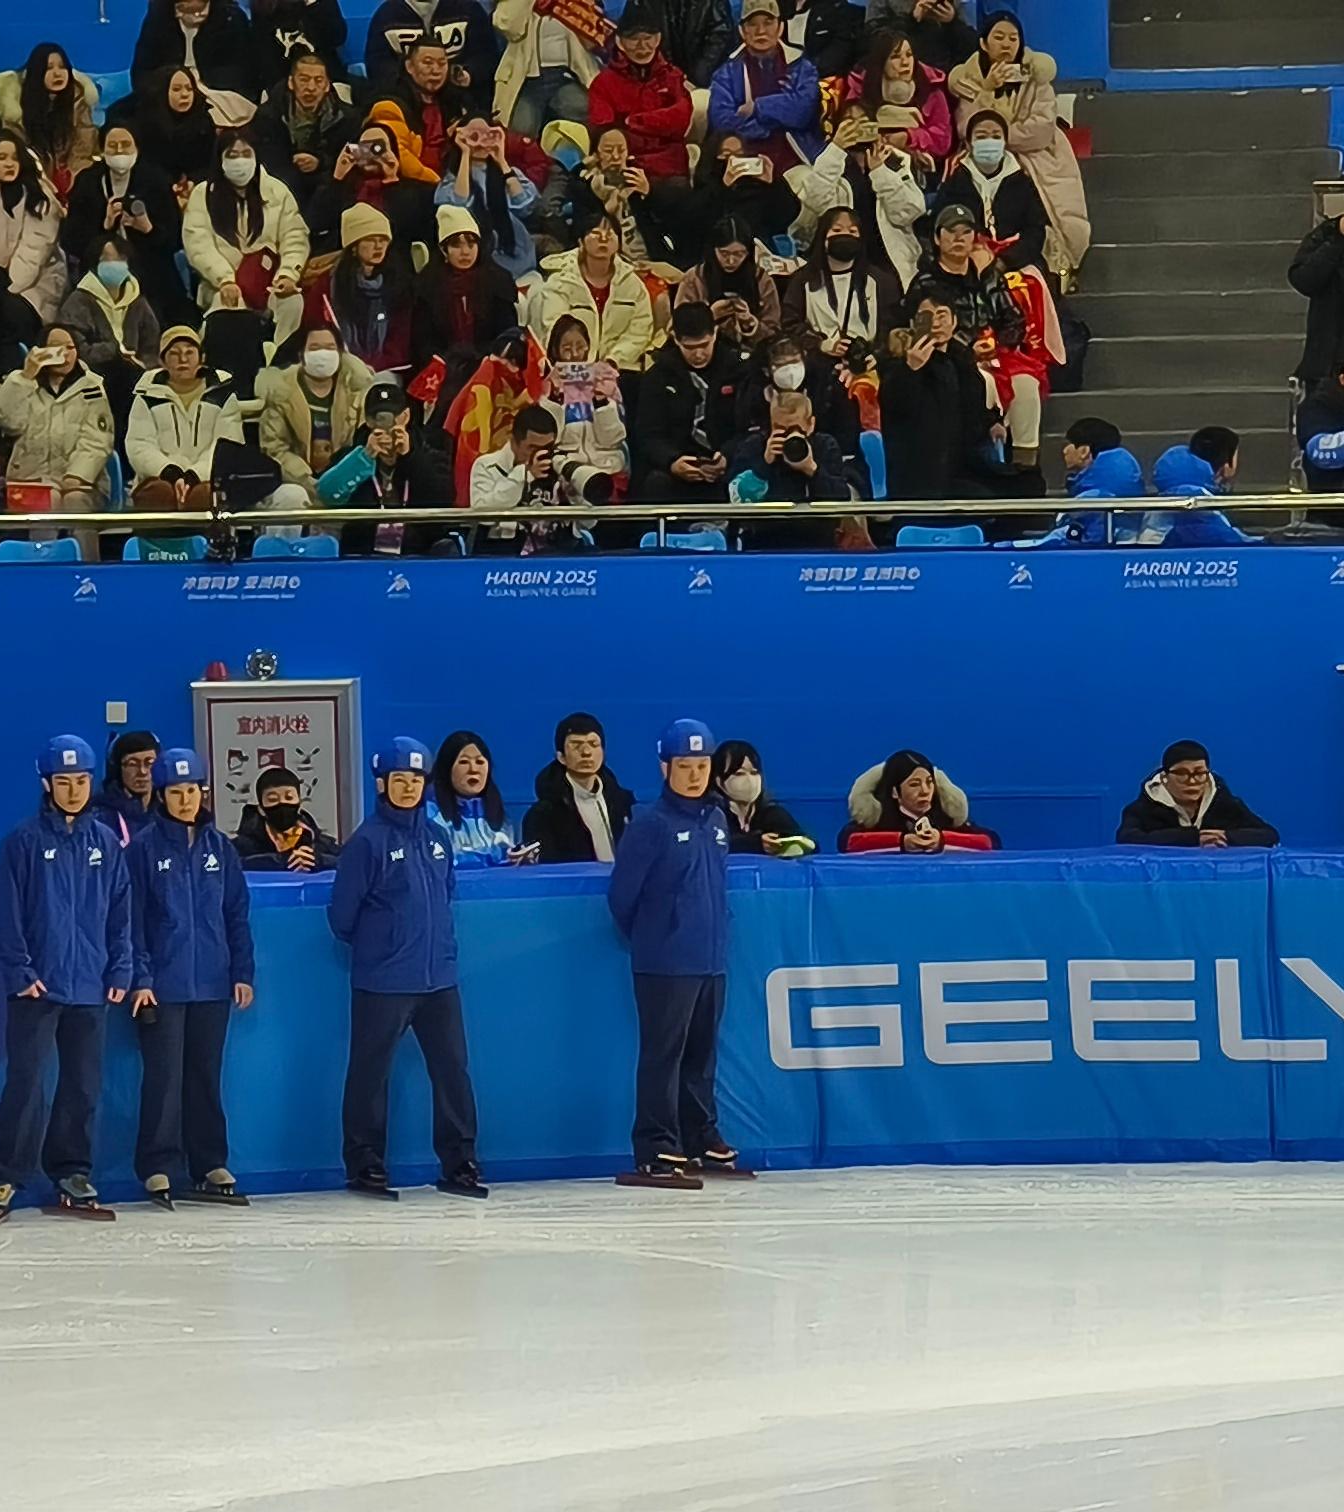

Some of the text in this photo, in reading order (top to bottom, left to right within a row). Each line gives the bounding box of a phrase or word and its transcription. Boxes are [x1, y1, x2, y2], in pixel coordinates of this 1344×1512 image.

[1123, 560, 1238, 577] HARBIN 2025
[484, 569, 597, 586] HARBIN 2025
